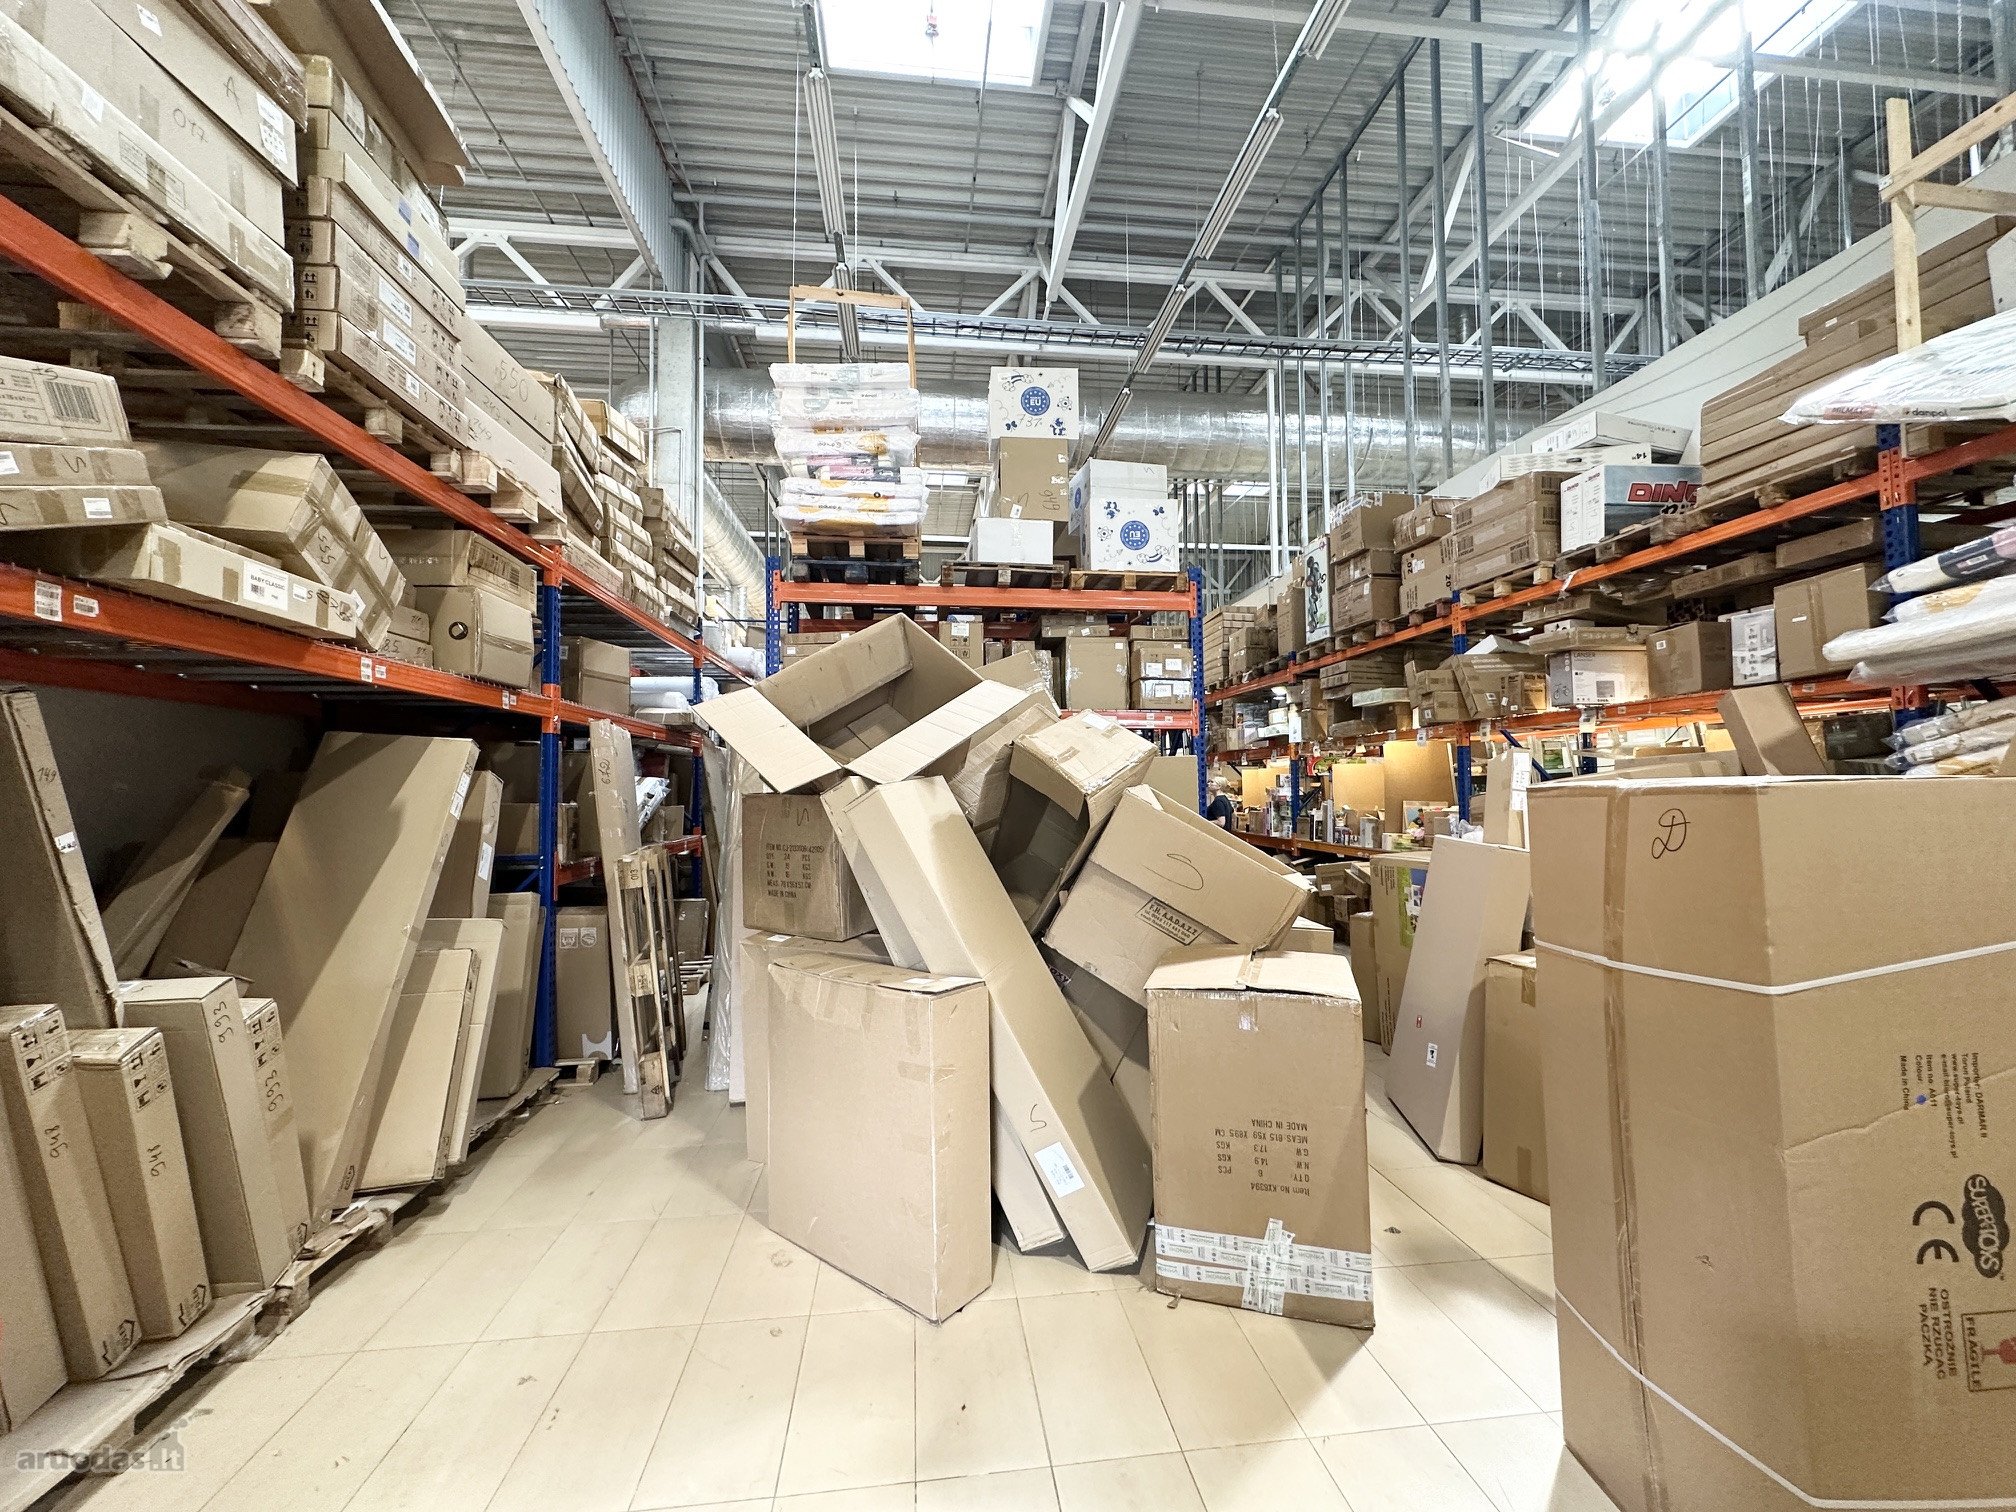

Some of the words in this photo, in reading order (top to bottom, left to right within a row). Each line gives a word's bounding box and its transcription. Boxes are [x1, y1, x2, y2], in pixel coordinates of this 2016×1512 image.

[1030, 398, 1041, 406] EU
[1900, 1055, 1908, 1077] Made
[1902, 1087, 1910, 1111] China
[1251, 1118, 1273, 1128] CHINA
[1275, 1120, 1283, 1129] IN
[1286, 1121, 1308, 1131] MADE
[1215, 1141, 1231, 1149] KGS
[1217, 1153, 1232, 1162] KGS
[1217, 1165, 1232, 1174] PCS
[1292, 1187, 1310, 1197] Item
[1929, 1287, 1939, 1312] NIE
[1966, 1316, 1983, 1390] FRAGILE
